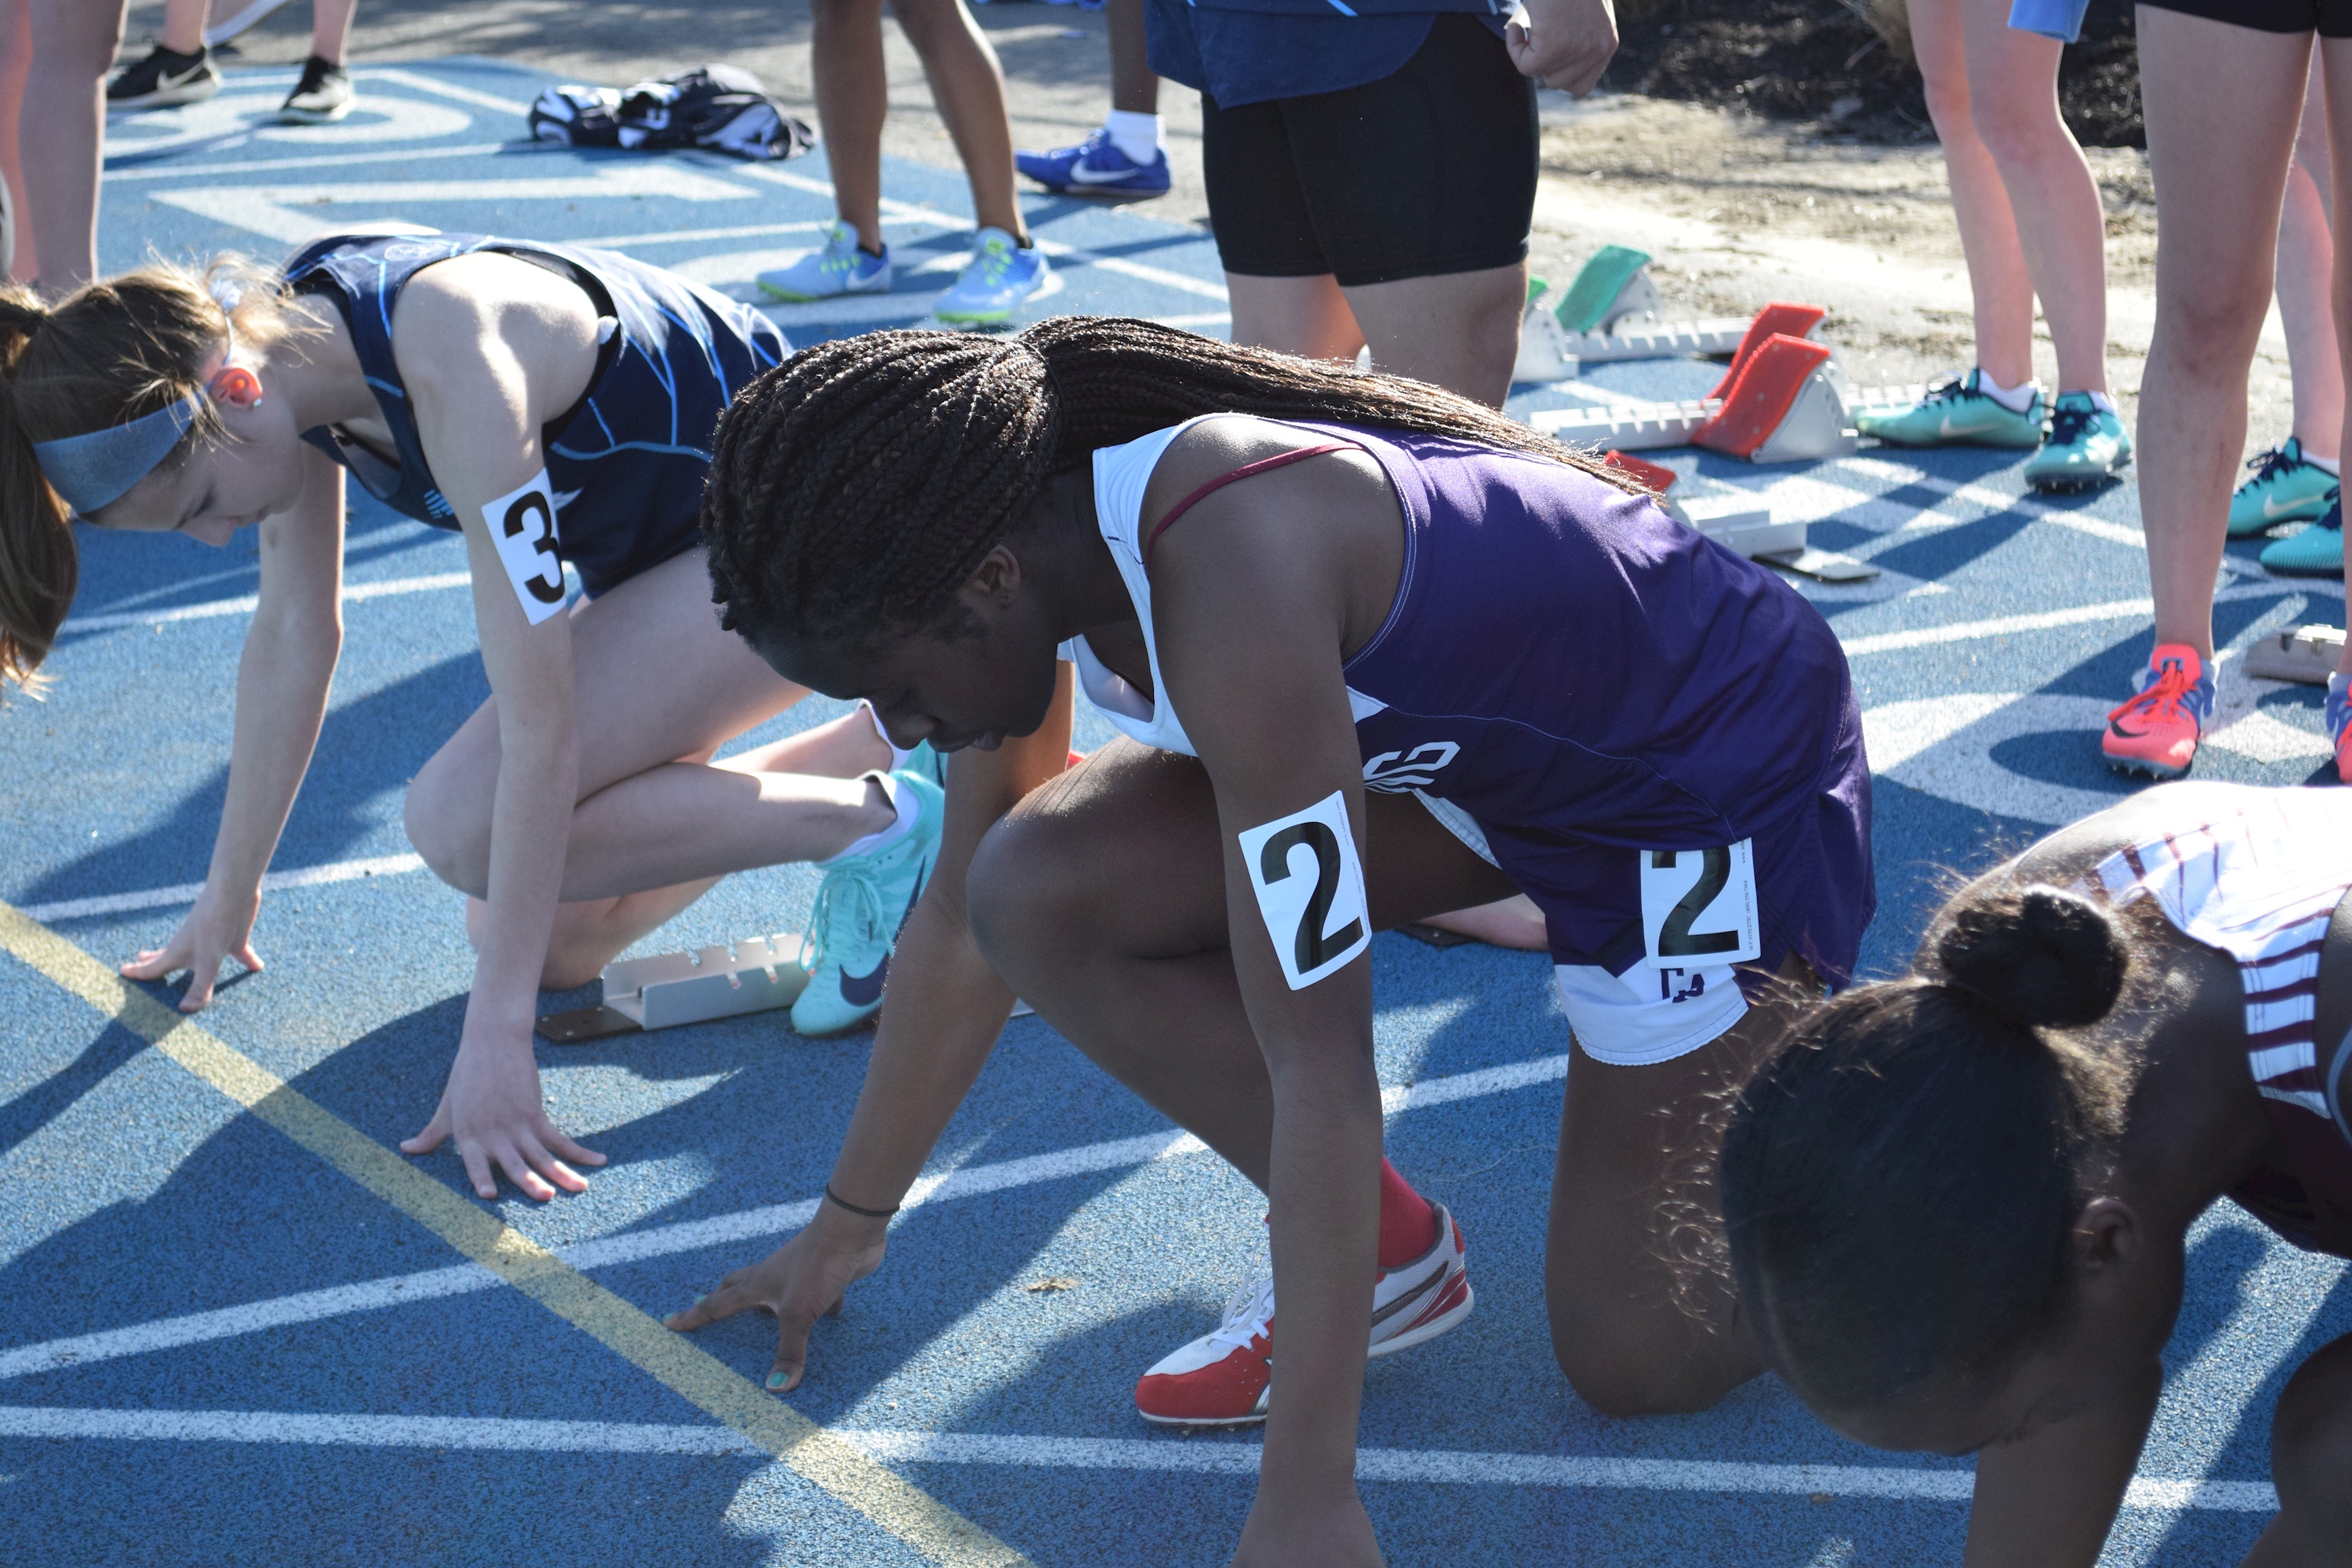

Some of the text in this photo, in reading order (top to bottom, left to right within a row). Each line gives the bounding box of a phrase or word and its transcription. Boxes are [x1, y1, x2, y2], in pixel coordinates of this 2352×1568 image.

[503, 490, 566, 604] 3
[1260, 822, 1364, 975] 2
[1651, 846, 1739, 957] 2
